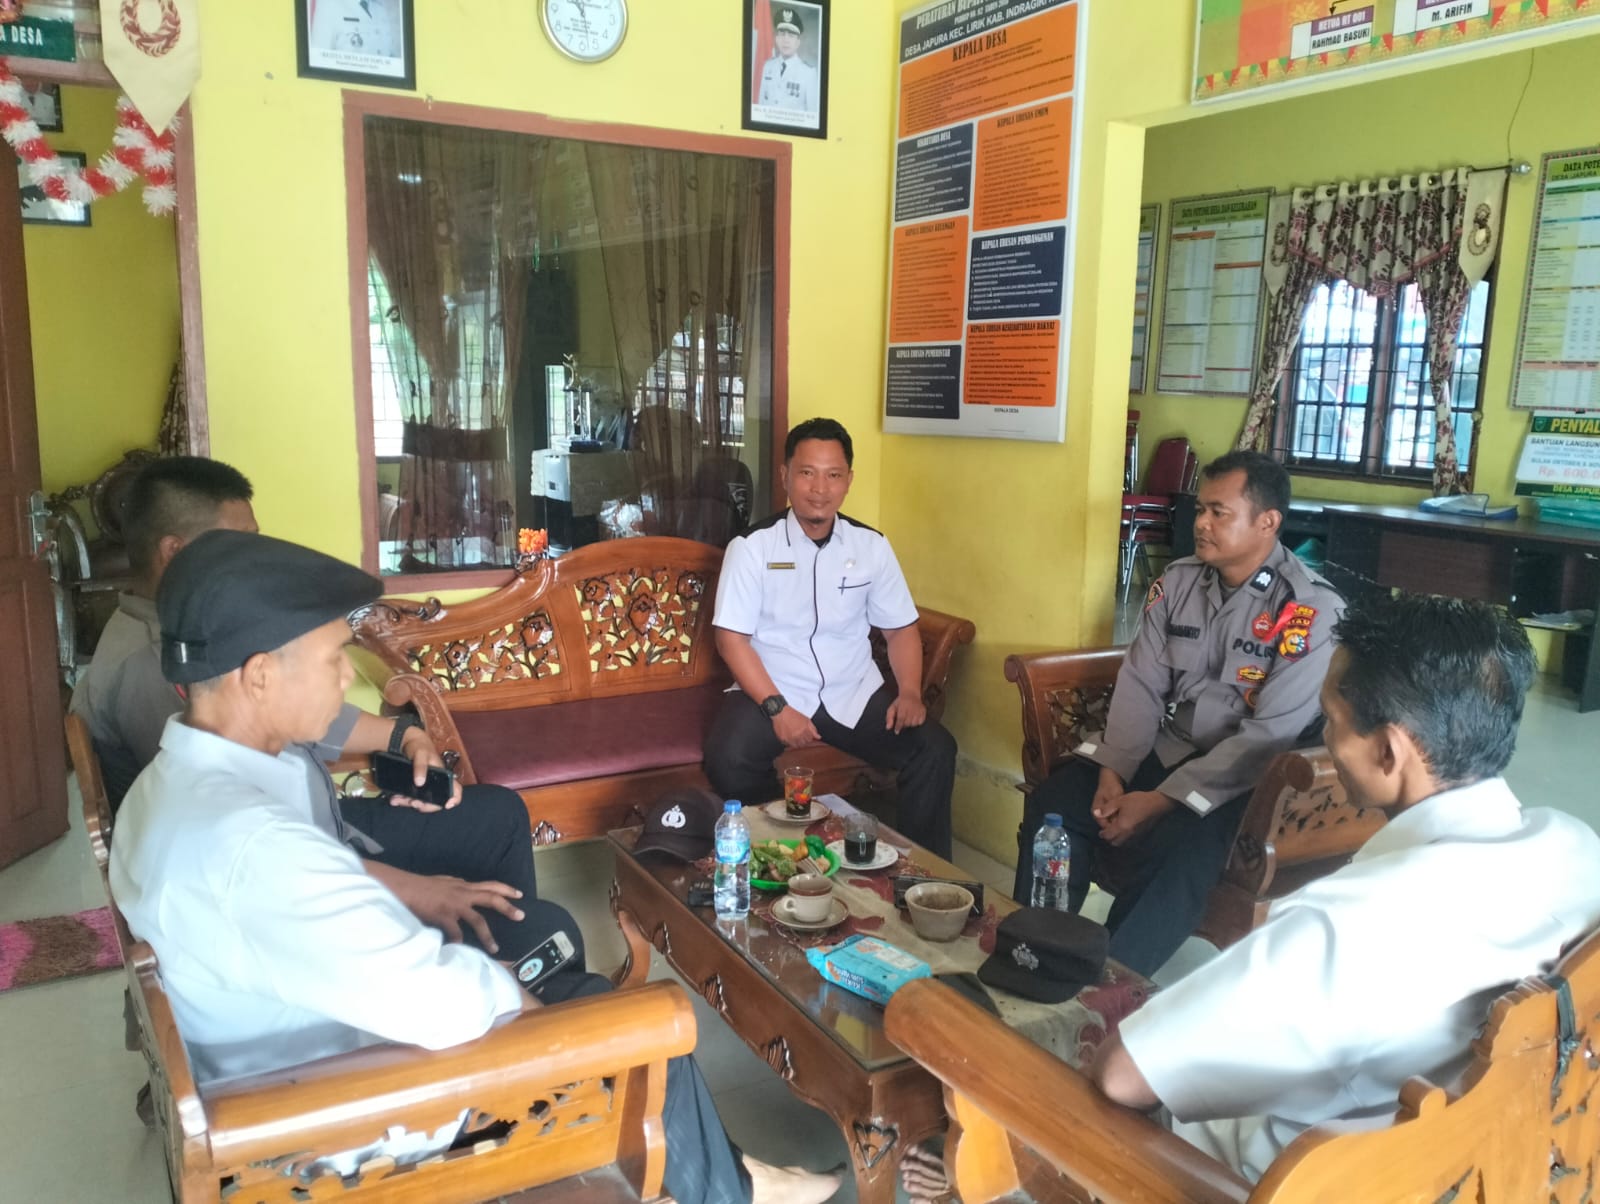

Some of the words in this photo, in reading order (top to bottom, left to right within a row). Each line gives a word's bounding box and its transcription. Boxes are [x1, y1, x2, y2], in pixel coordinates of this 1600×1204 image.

[916, 0, 957, 29] PERATURAN
[1342, 14, 1351, 26] RT
[1431, 10, 1442, 22] M.
[1445, 2, 1472, 20] ARIFIN
[11, 25, 44, 46] DESA
[904, 42, 921, 58] DESA
[921, 32, 948, 51] JAPURA
[948, 27, 966, 45] KEC.
[966, 17, 986, 34] LIRIK
[986, 11, 1004, 27] KAB.
[953, 36, 984, 62] KEPALA
[986, 28, 1007, 50] DESA
[1312, 34, 1341, 49] RAHMAD
[1343, 27, 1370, 44] BASUKI
[1563, 161, 1582, 172] DATA
[1531, 437, 1564, 446] BANTUAN
